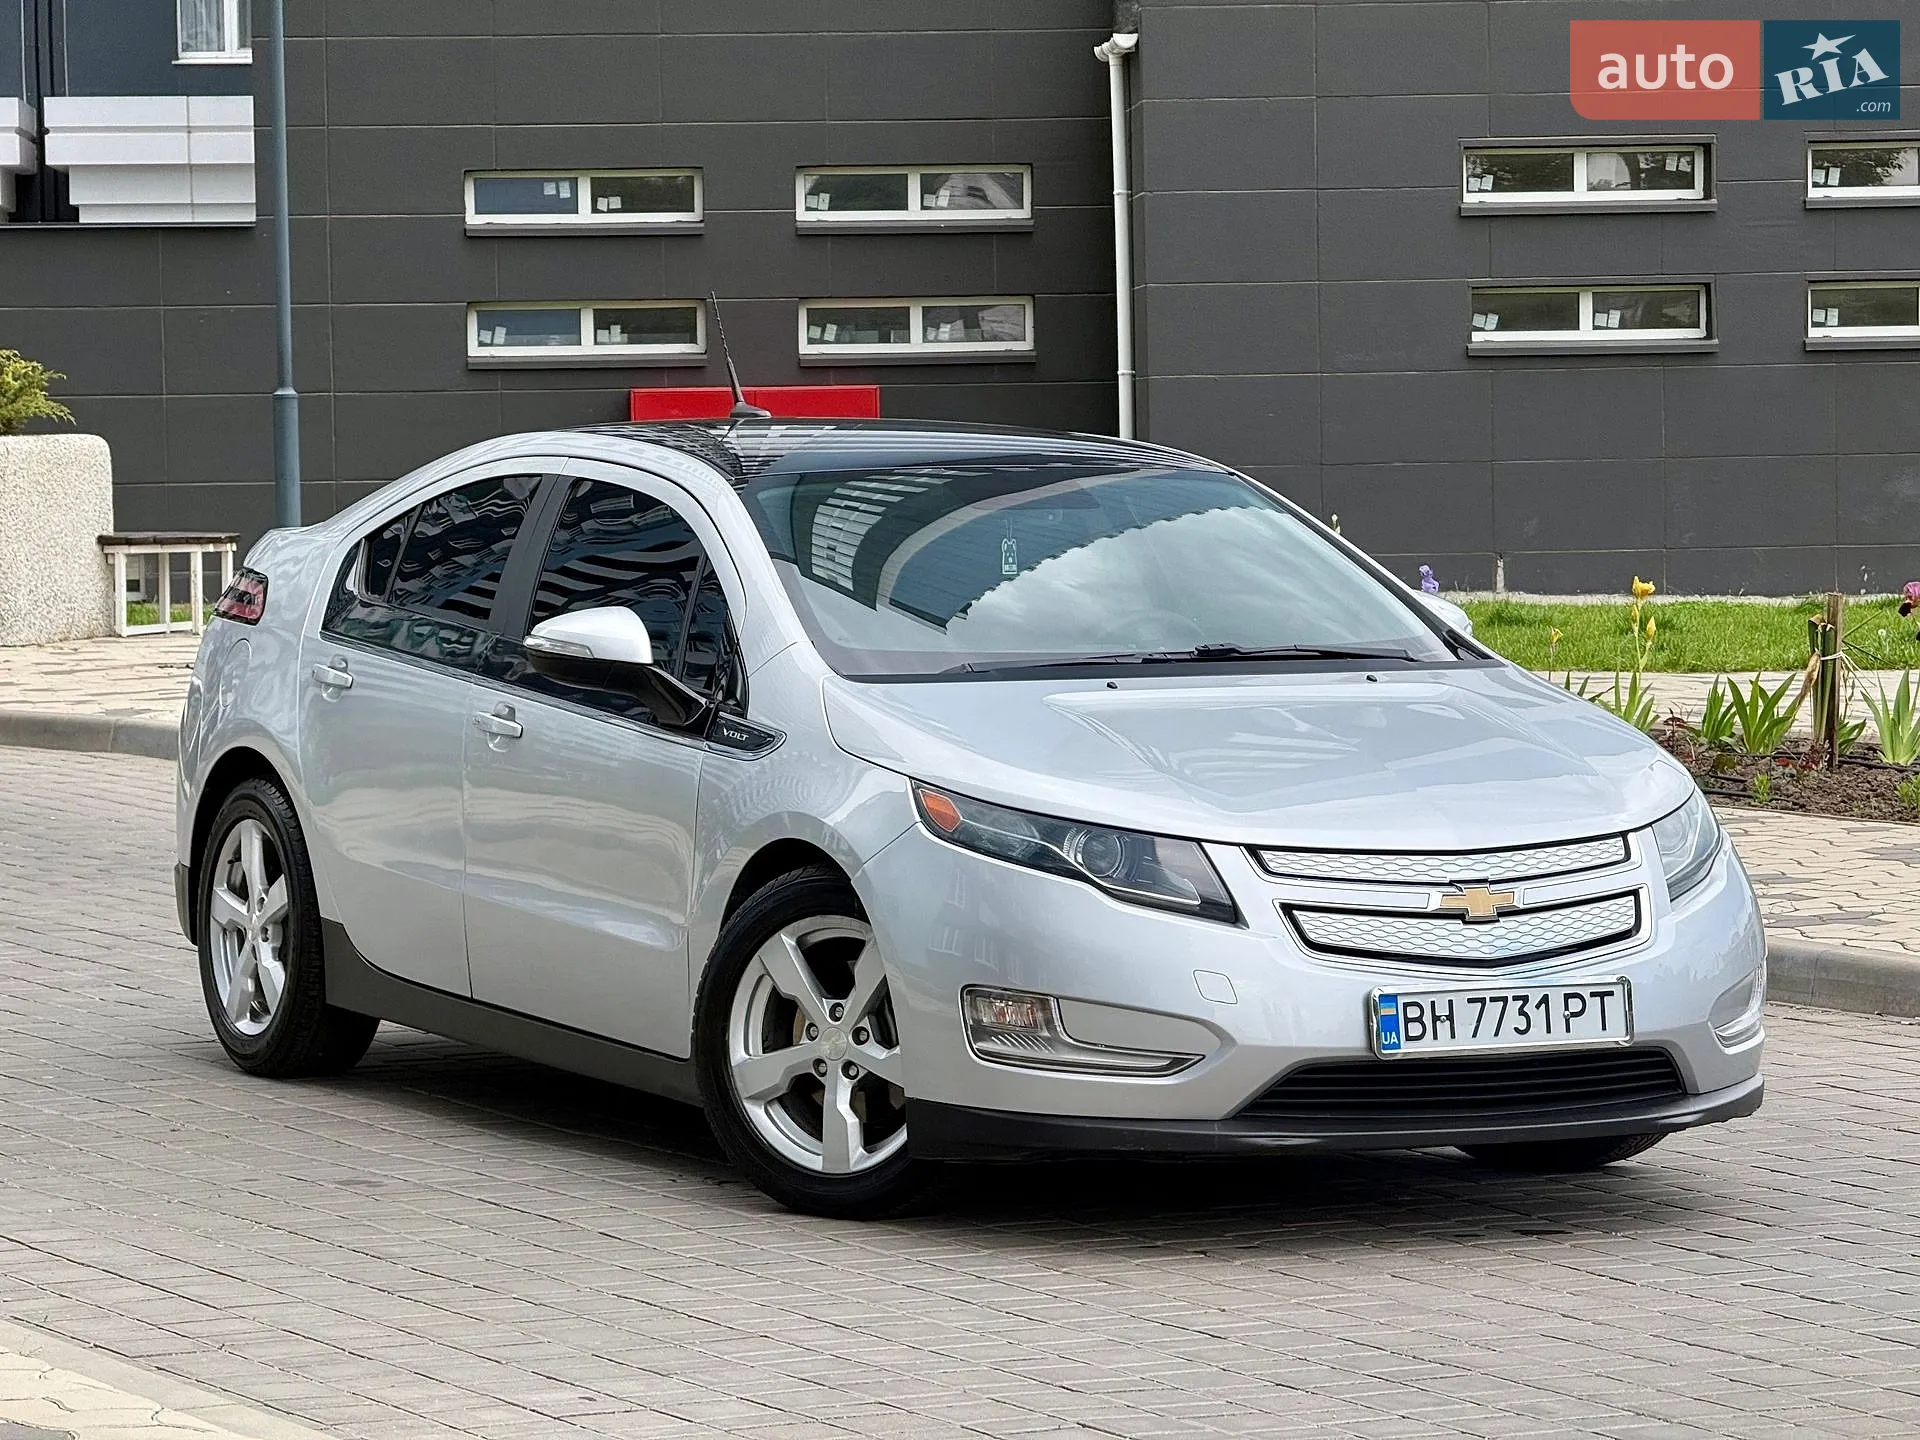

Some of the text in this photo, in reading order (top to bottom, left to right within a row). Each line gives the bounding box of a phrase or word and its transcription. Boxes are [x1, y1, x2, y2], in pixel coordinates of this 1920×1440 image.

[723, 727, 749, 741] VOLT
[1402, 991, 1615, 1042] BH 7731 PT
[1382, 1033, 1399, 1046] UA
